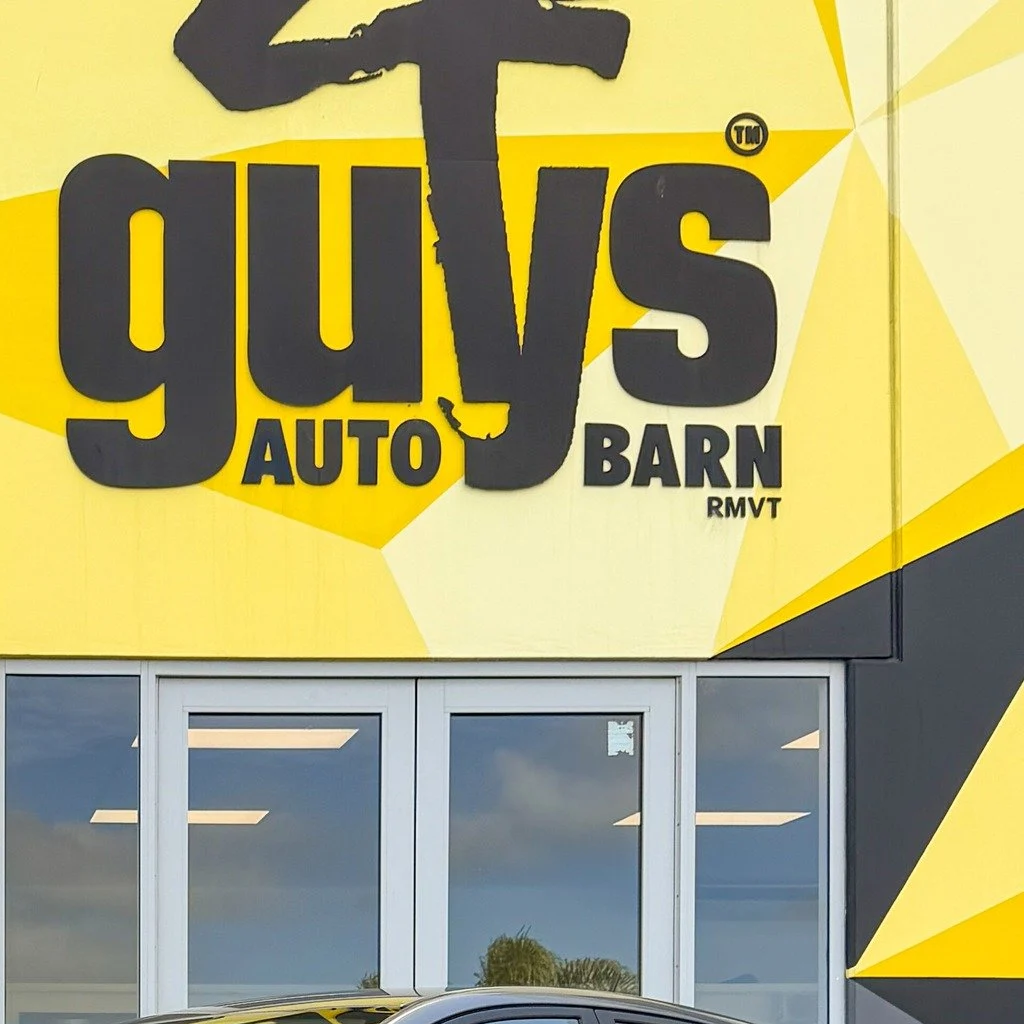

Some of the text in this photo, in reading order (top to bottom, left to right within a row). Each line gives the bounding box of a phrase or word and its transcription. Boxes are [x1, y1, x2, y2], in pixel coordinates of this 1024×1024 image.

[58, 153, 778, 490] guys
[241, 418, 782, 488] AUTO BARN
[706, 496, 782, 519] RMVT
